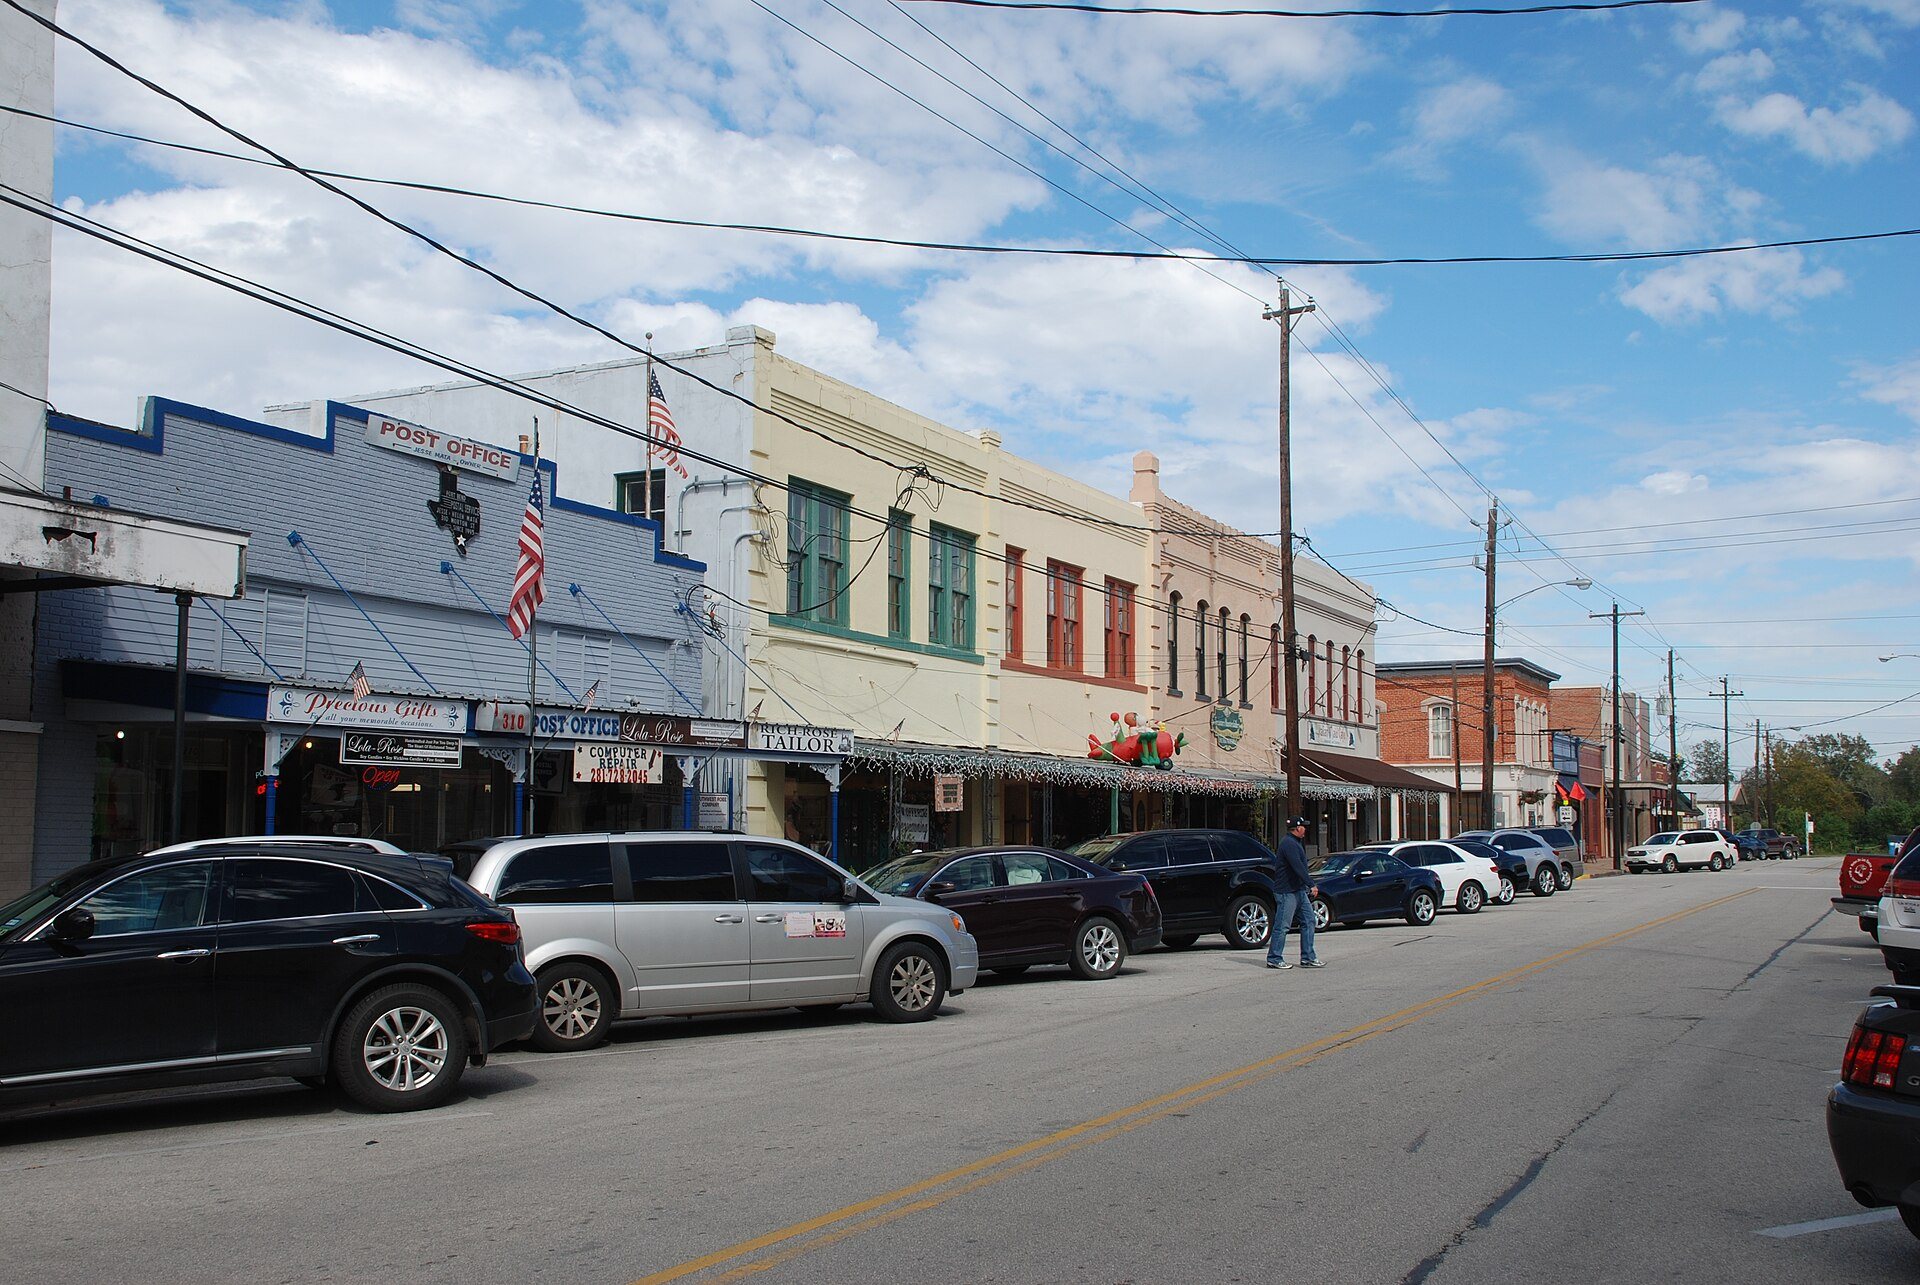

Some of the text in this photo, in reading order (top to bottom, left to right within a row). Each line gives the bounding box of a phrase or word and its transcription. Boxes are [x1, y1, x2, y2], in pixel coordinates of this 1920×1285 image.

[380, 421, 512, 469] POST OFFICE
[413, 447, 432, 457] JESSE
[434, 452, 451, 461] MATA
[459, 459, 481, 469] OWNER
[304, 691, 438, 720] Precious Gifts
[340, 716, 357, 724] your
[359, 717, 399, 726] memorable
[400, 720, 434, 728] occasions.
[502, 713, 525, 730] 310
[570, 715, 619, 737] OFFICE
[760, 723, 838, 739] RICH-ROSE
[589, 746, 647, 760] COMPUTER
[761, 734, 835, 753] TAILOR
[599, 757, 638, 770] REPAIR
[362, 766, 400, 789] Open
